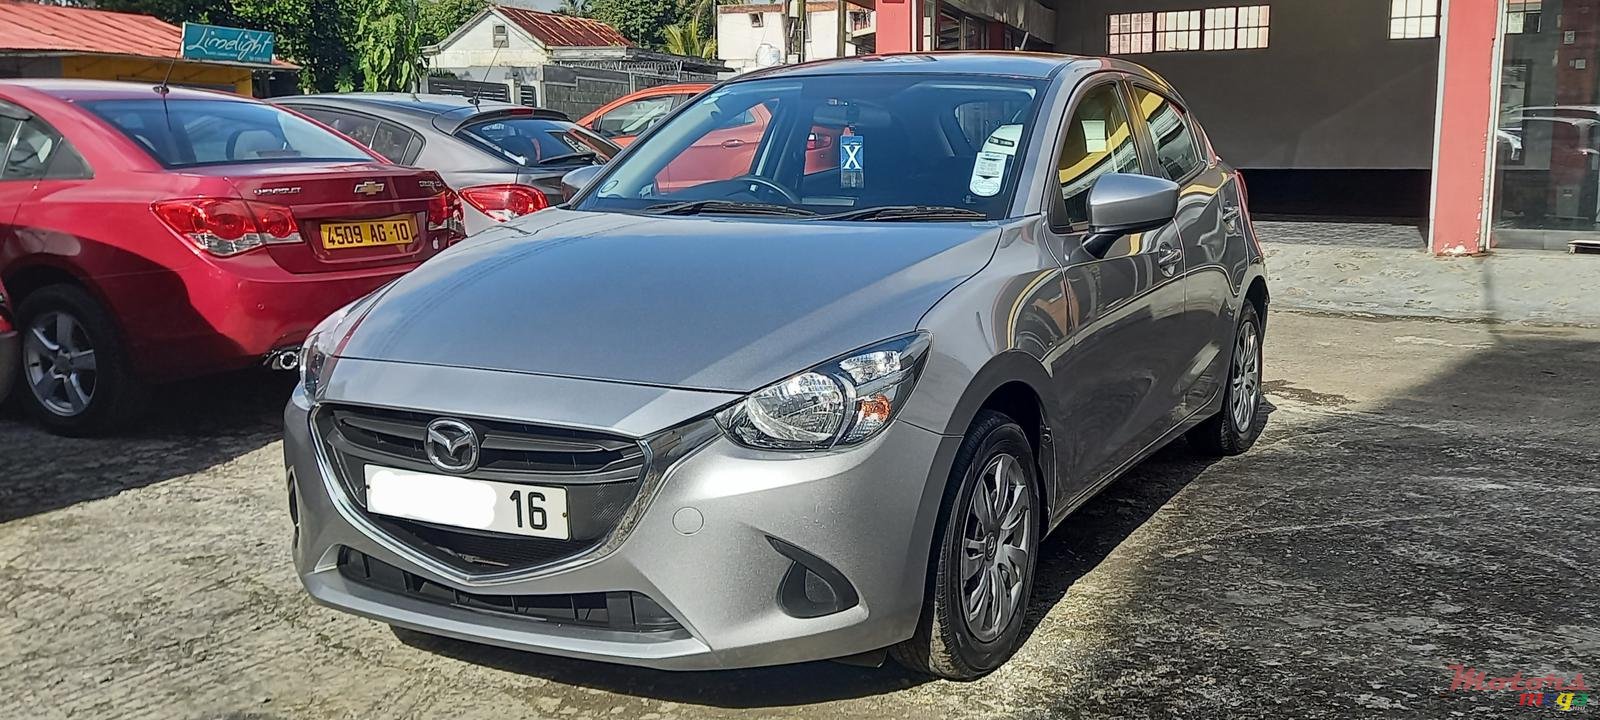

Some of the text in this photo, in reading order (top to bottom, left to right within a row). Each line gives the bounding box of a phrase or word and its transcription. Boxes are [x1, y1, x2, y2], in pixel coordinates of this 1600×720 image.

[186, 27, 272, 60] Limelight
[842, 145, 862, 170] X
[328, 225, 364, 246] 4509
[369, 223, 387, 242] AG
[509, 489, 548, 531] 16
